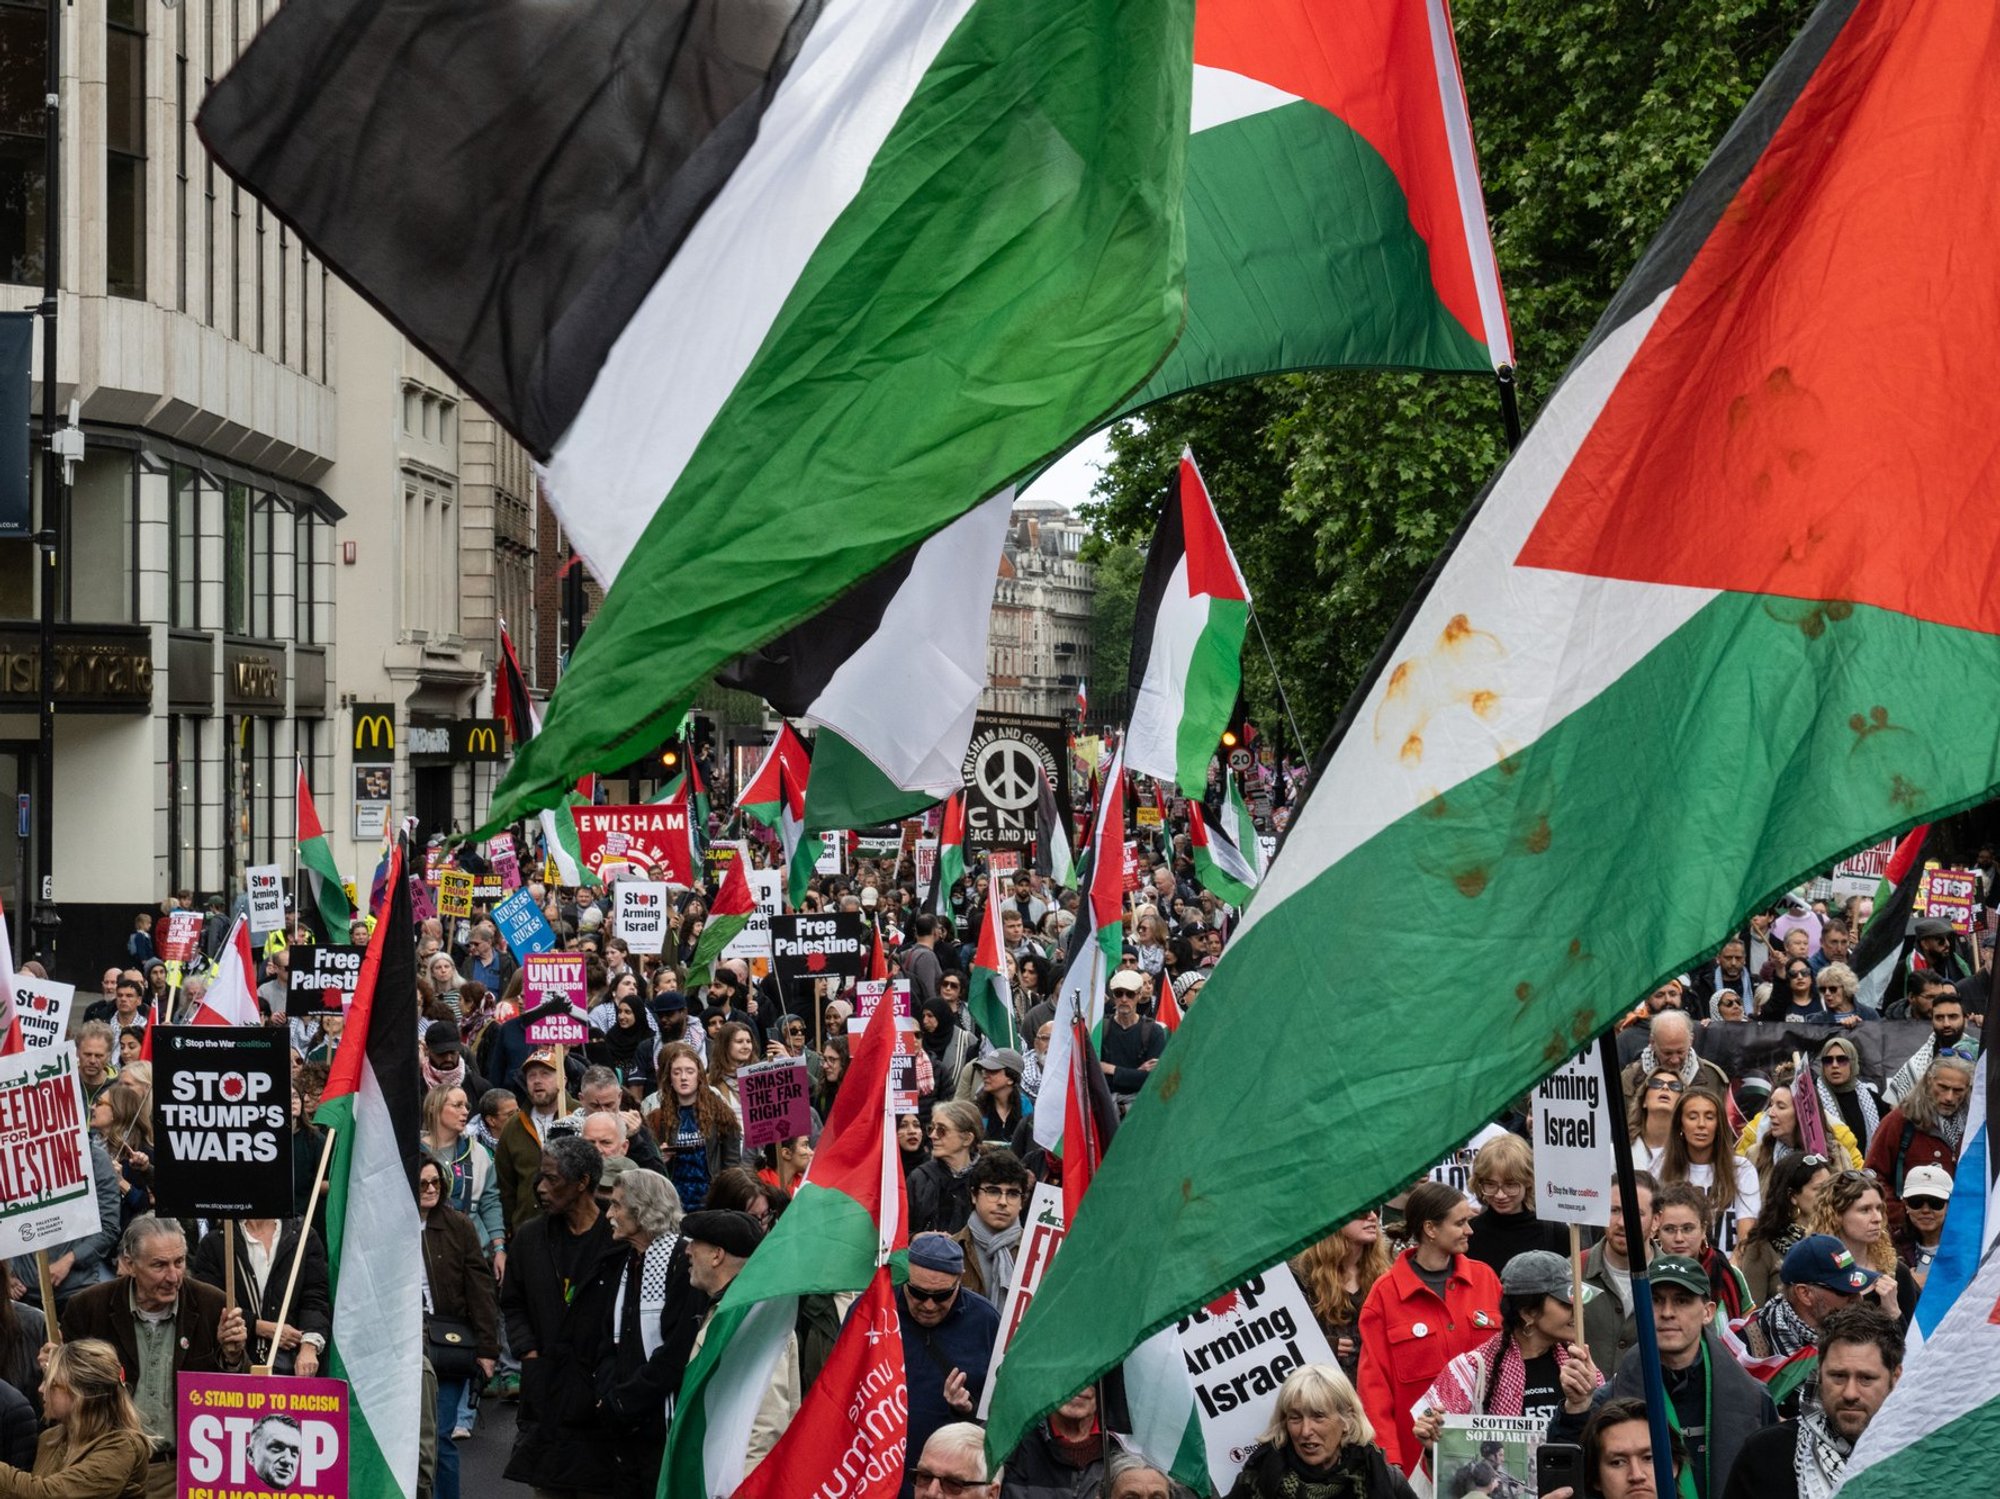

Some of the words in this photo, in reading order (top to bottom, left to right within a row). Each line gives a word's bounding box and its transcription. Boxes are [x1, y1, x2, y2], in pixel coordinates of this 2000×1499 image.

[962, 728, 996, 787] LEWISHAM
[998, 726, 1022, 740] AND
[1231, 754, 1250, 765] 20
[576, 813, 685, 832] EWISHAM
[968, 806, 1039, 829] CN
[998, 829, 1021, 842] AND
[428, 853, 453, 864] STP
[650, 846, 675, 880] WAR
[1838, 851, 1891, 876] ALESTINE
[251, 875, 276, 888] Stop
[252, 888, 279, 899] Arming
[624, 892, 658, 907] Stop
[254, 899, 278, 912] Israel
[496, 892, 529, 922] NURSES
[622, 908, 661, 920] Arming
[510, 909, 529, 928] NOT
[625, 920, 658, 932] Israel
[796, 917, 837, 936] Free
[513, 919, 541, 944] NUKES
[774, 935, 858, 957] Palestine
[314, 948, 360, 969] Free
[291, 969, 358, 990] Palesti
[527, 964, 582, 982] UNITY
[528, 982, 547, 991] OVER
[548, 982, 583, 991] DIVISION
[16, 989, 60, 1015] Stop
[861, 995, 901, 1006] WON
[861, 1004, 906, 1017] AGST
[545, 1016, 557, 1025] NO
[558, 1016, 568, 1025] TO
[531, 1025, 583, 1040] RACISM
[185, 1039, 204, 1049] Stop
[205, 1039, 218, 1048] the
[219, 1040, 236, 1048] War
[236, 1040, 271, 1048] coalition
[171, 1070, 272, 1102] STOP
[745, 1069, 794, 1092] SMASH
[1539, 1068, 1599, 1109] Arming
[747, 1089, 773, 1107] THE
[777, 1084, 802, 1101] FAR
[160, 1104, 285, 1128] TRUMP'S
[749, 1101, 790, 1124] RIGHT
[2, 1131, 28, 1145] FOR
[1544, 1108, 1596, 1148] Israel
[167, 1131, 278, 1162] WARS
[0, 1128, 85, 1202] LESTINE
[1183, 1306, 1298, 1376] Arming
[1195, 1340, 1306, 1419] Israel
[204, 1390, 244, 1408] STAND
[247, 1393, 265, 1409] UP
[269, 1394, 286, 1410] TO
[290, 1395, 340, 1412] RACISM
[1472, 1418, 1533, 1430] SCOTTISH
[1465, 1430, 1542, 1443] SOLIDARITY
